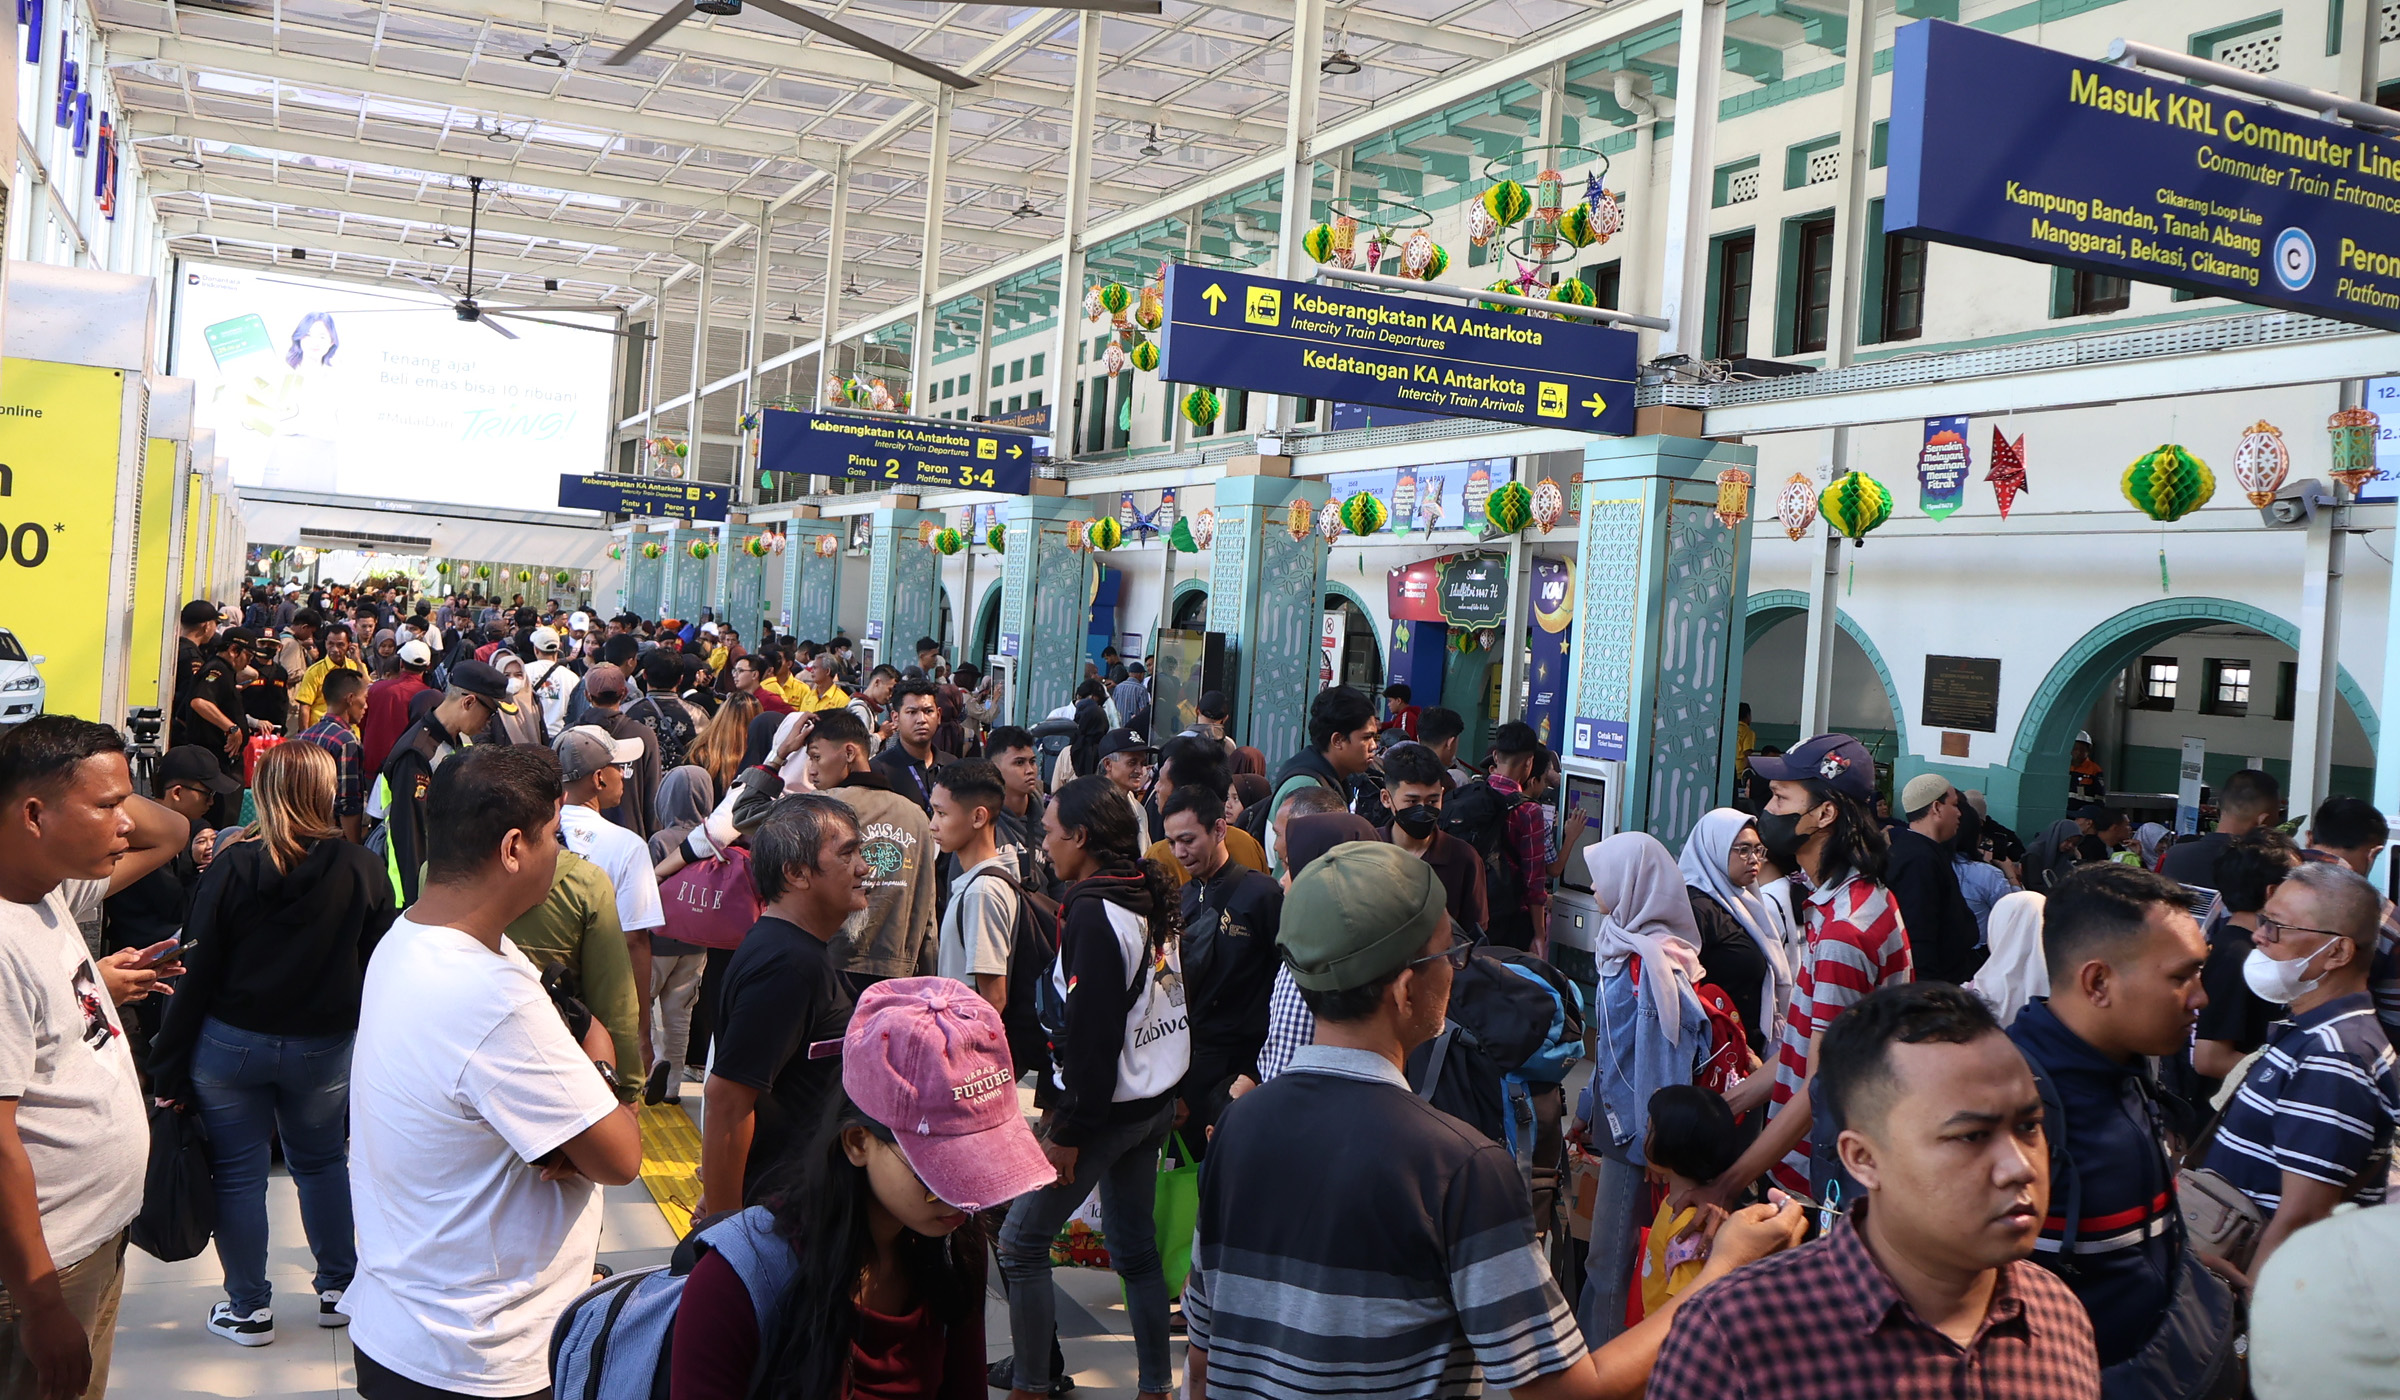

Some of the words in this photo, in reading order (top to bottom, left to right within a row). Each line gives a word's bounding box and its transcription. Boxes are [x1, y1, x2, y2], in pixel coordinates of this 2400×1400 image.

[2069, 69, 2160, 122] Masuk
[2168, 95, 2219, 136] KRL
[2224, 110, 2353, 169] Commuter
[2358, 143, 2400, 180] Line
[2197, 145, 2284, 187] Commuter
[2288, 168, 2329, 199] Train
[2335, 179, 2400, 215] Entrance
[2006, 180, 2087, 223] Kampung
[2092, 199, 2158, 236] Bandan,
[2163, 214, 2209, 242] Tanah
[2213, 223, 2261, 258] Abang
[2156, 188, 2209, 216] Cikarang
[2211, 200, 2236, 223] Loop
[2240, 206, 2263, 226] Line
[2031, 218, 2125, 260] Manggarai,
[2131, 238, 2186, 270] Bekasi,
[2192, 252, 2259, 287] Cikarang
[2340, 238, 2400, 277] Peron
[2336, 277, 2400, 310] Platform
[1292, 317, 1343, 337] Intercity
[1345, 324, 1376, 340] Train
[1379, 329, 1445, 350] Departures
[1293, 293, 1427, 329] Keberangkatan
[1431, 313, 1456, 333] KA
[1460, 317, 1542, 346] Antarkota
[383, 351, 440, 374] Tenang
[1303, 350, 1408, 380] Kedatangan
[1413, 364, 1439, 383] KA
[1444, 368, 1525, 396] Antarkota
[380, 371, 408, 385] Beli
[415, 377, 458, 391] emas
[464, 380, 496, 394] bisa
[525, 387, 577, 402] ribuan!
[1398, 385, 1446, 407] Intercity
[1447, 391, 1478, 407] Train
[1480, 394, 1524, 414] Arrivals
[811, 418, 895, 439] Keberangkatan
[897, 428, 914, 440] KA
[916, 431, 970, 447] Antarkota
[874, 440, 906, 451] Intercity
[908, 442, 926, 452] Train
[928, 445, 969, 457] Departures
[1924, 450, 1965, 463] Melayani
[1926, 441, 1963, 453] Semakin
[848, 454, 877, 467] Pintu
[885, 459, 899, 478] 2
[918, 461, 948, 474] Peron
[848, 467, 866, 476] Gate
[916, 474, 952, 485] Platforms
[1921, 459, 1967, 471] Menemani
[1926, 469, 1958, 482] Menuju
[582, 477, 635, 488] Keberangkatan
[636, 480, 647, 489] KA
[648, 484, 682, 492] Antarkota
[1928, 480, 1955, 489] Fitrah
[645, 502, 651, 514] 1
[665, 503, 684, 511] Peron
[689, 506, 696, 518] 1
[1542, 582, 1564, 600] KAI
[677, 881, 723, 909] ELLE
[952, 1068, 1011, 1101] FUTURE
[964, 1065, 996, 1083] URBAN
[973, 1088, 1002, 1105] AXIOMS
